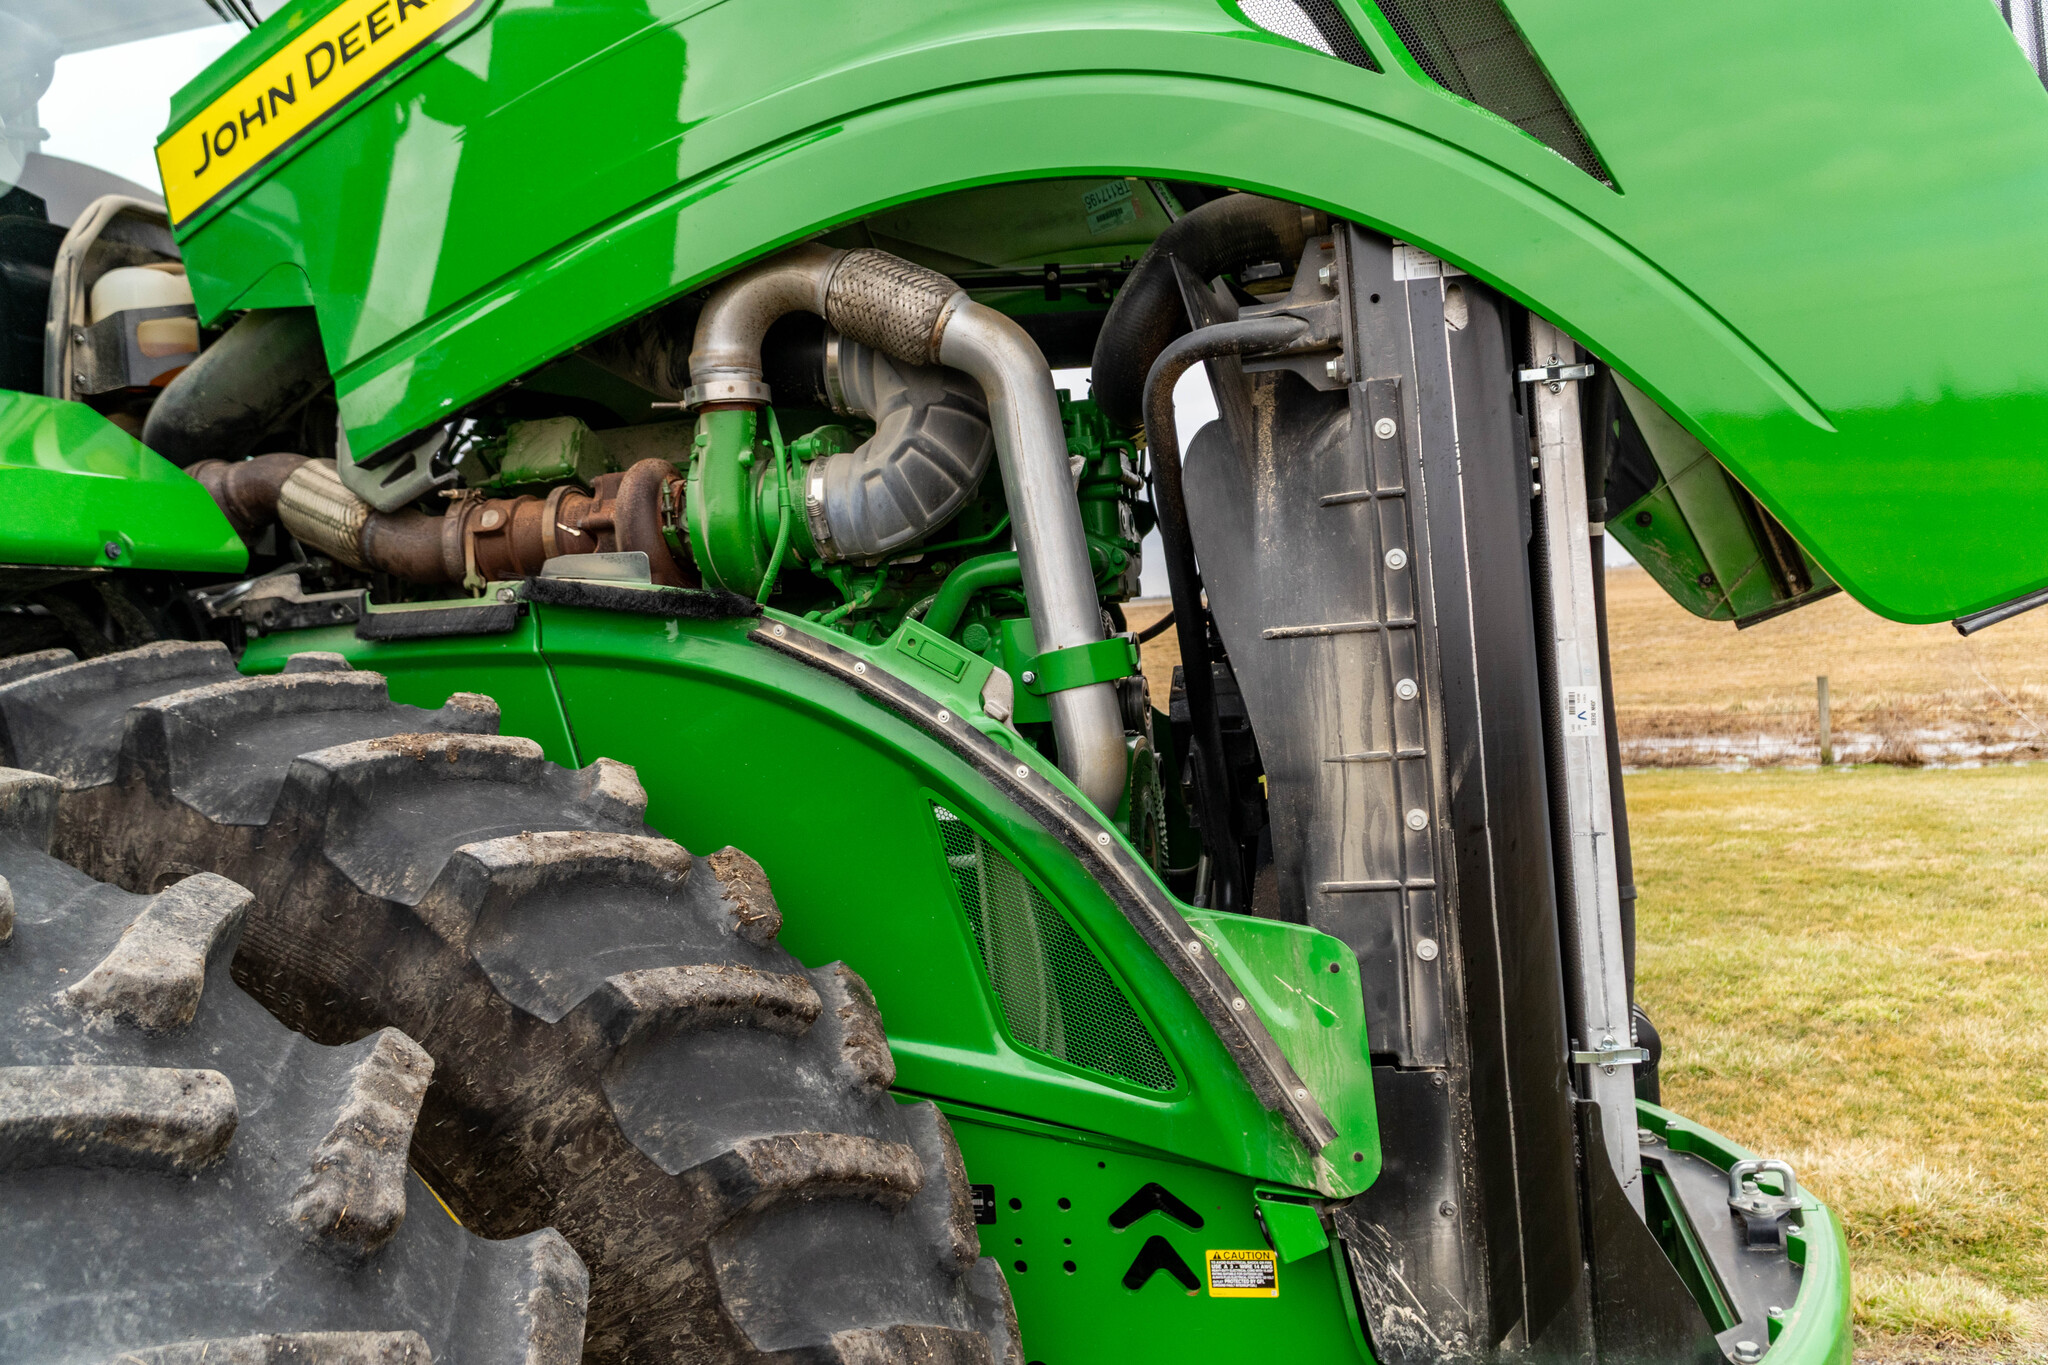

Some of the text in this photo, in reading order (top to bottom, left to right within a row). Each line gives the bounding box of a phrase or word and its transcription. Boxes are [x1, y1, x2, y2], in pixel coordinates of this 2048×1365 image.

[194, 0, 434, 178] JOHN DEER
[1223, 1251, 1270, 1260] CAUTION
